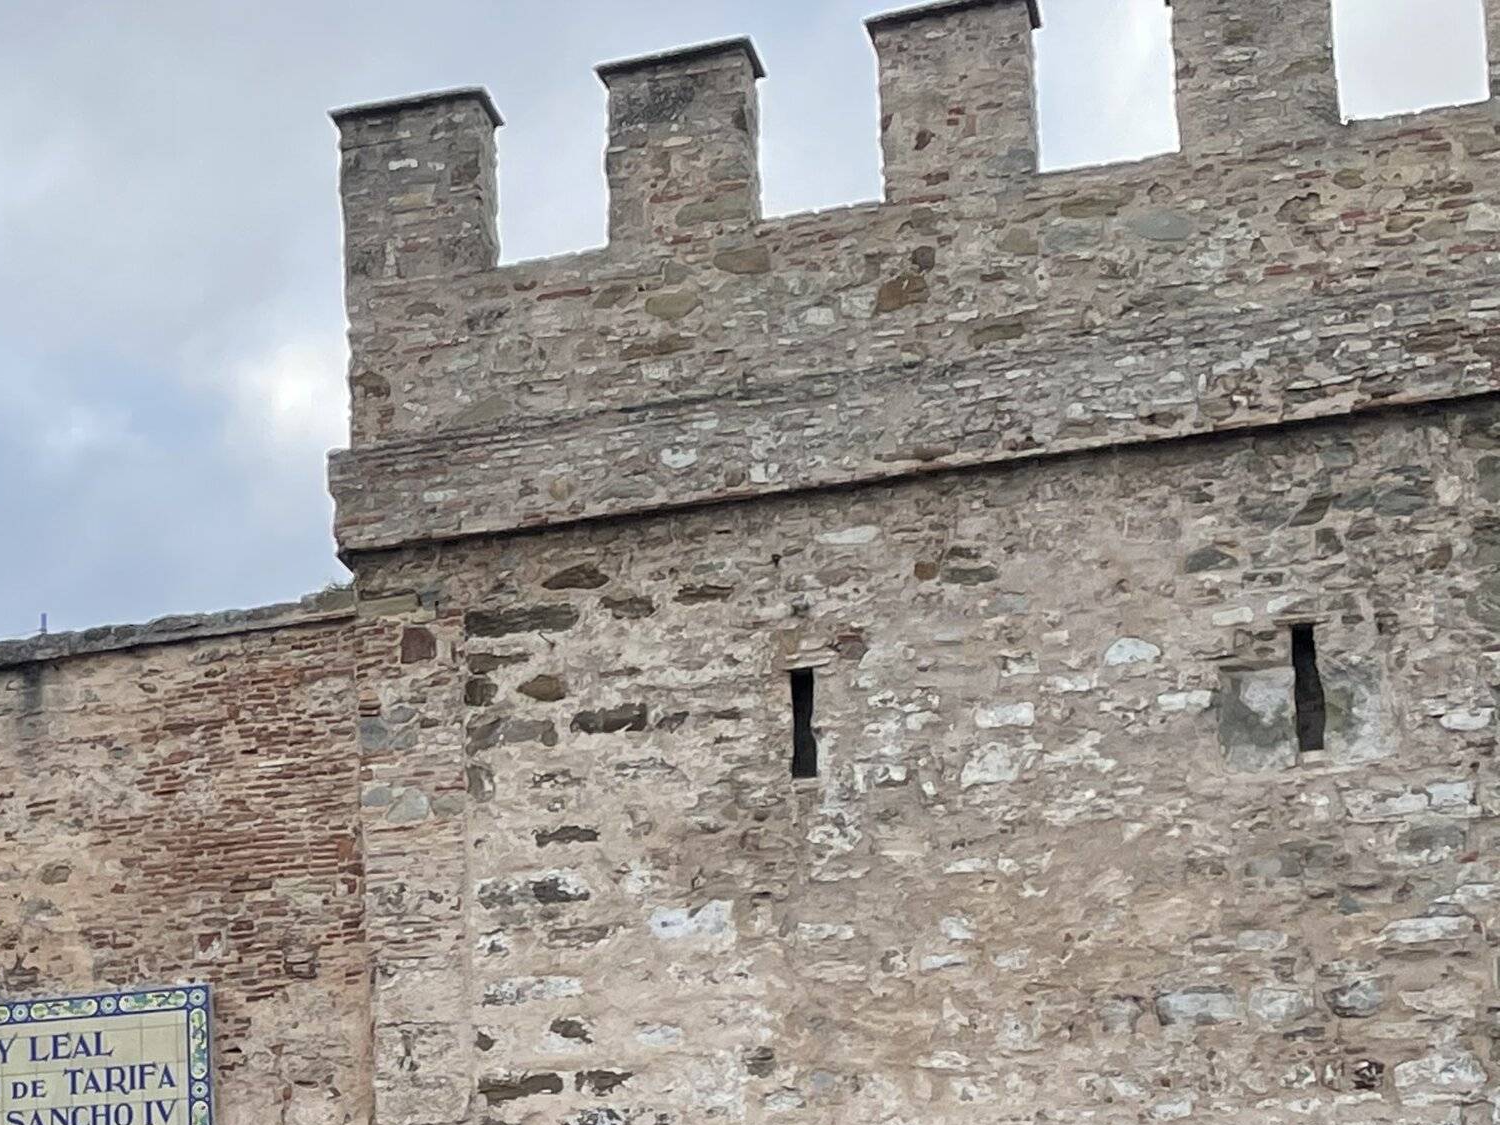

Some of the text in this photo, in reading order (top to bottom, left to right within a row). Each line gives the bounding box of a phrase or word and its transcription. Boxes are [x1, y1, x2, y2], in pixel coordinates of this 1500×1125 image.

[29, 1031, 114, 1062] LEAL
[11, 1079, 47, 1100] DE
[62, 1061, 177, 1096] TARIFA
